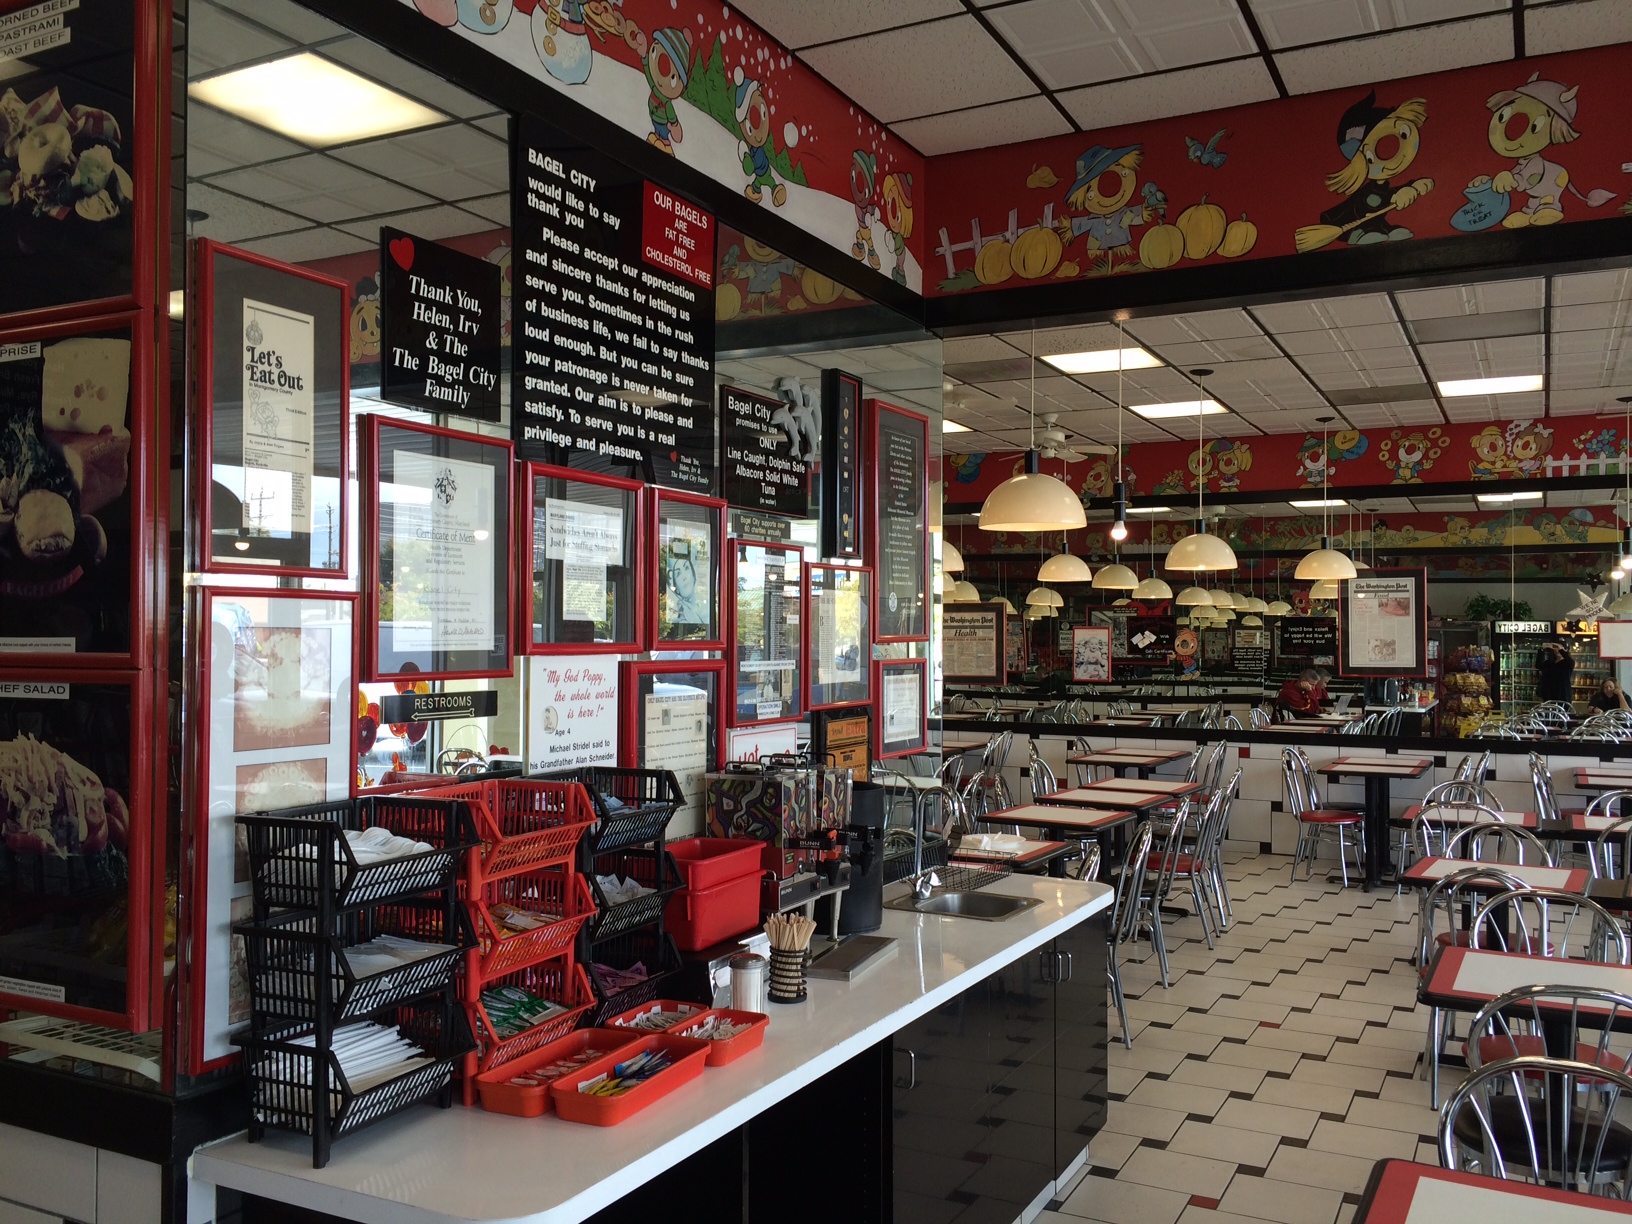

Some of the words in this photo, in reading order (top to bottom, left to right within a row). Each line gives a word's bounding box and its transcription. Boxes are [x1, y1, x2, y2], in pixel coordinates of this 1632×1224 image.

[34, 31, 65, 48] BEEF
[529, 148, 566, 179] BAGEL
[571, 170, 596, 192] CITY
[528, 177, 562, 201] would
[566, 191, 584, 211] like
[589, 203, 599, 218] to
[603, 212, 620, 230] say
[528, 193, 560, 218] thank
[565, 211, 584, 229] you
[654, 191, 672, 210] OUR
[675, 203, 707, 229] BAGELS
[1461, 202, 1485, 216] TRICK
[674, 219, 687, 233] ARE
[1468, 211, 1493, 226] TREAT
[665, 228, 676, 242] FAT
[679, 234, 695, 251] FREE
[543, 227, 580, 254] Please
[584, 248, 619, 271] accept
[623, 264, 638, 278] our
[642, 271, 695, 302] appreciation
[673, 246, 687, 260] AND
[646, 247, 693, 277] CHOLESTEROL
[695, 268, 711, 284] FREE
[409, 275, 452, 305] Thank
[456, 289, 482, 316] You,
[526, 249, 547, 266] and
[552, 258, 591, 283] sincere
[596, 276, 629, 298] thanks
[633, 288, 646, 304] for
[650, 295, 677, 320] letting
[680, 310, 690, 321] us
[412, 302, 453, 333] Helen,
[458, 314, 479, 336] Irv
[526, 275, 557, 294] serve
[562, 287, 584, 305] you.
[589, 295, 642, 325] Sometimes
[646, 316, 654, 329] in
[658, 321, 672, 336] the
[675, 330, 693, 344] rush
[426, 331, 438, 350] &
[444, 334, 468, 357] The
[526, 299, 536, 312] of
[541, 303, 589, 330] business
[593, 320, 611, 340] life,
[616, 330, 629, 343] we
[633, 334, 647, 350] fail
[651, 341, 659, 353] to
[663, 346, 678, 362] say
[682, 351, 709, 371] thanks
[0, 345, 37, 357] PRISE
[246, 346, 282, 369] Let's
[525, 322, 549, 342] loud
[554, 335, 595, 357] enough.
[600, 346, 617, 363] But
[621, 354, 637, 369] you
[642, 362, 658, 376] can
[662, 366, 672, 380] be
[676, 372, 694, 386] sure
[246, 364, 275, 385] Eat
[278, 370, 303, 390] Out
[393, 347, 419, 370] The
[428, 355, 463, 382] Bagel
[469, 366, 497, 391] City
[526, 351, 550, 366] your
[555, 359, 608, 384] patronage
[612, 373, 620, 387] is
[624, 378, 649, 395] never
[654, 386, 677, 403] taken
[681, 393, 693, 407] for
[424, 378, 470, 408] Family
[525, 377, 570, 398] granted.
[575, 386, 593, 403] Our
[599, 394, 616, 409] aim
[620, 398, 628, 411] is
[633, 402, 641, 415] to
[645, 407, 673, 424] please
[678, 414, 693, 429] and
[728, 396, 752, 415] Bagel
[755, 404, 770, 422] City
[525, 400, 564, 422] satisfy.
[569, 409, 581, 423] To
[585, 414, 613, 432] serve
[617, 423, 634, 438] you
[638, 426, 645, 439] is
[649, 431, 655, 441] a
[659, 432, 675, 446] real
[736, 418, 760, 430] promises
[525, 426, 572, 447] privilege
[577, 436, 595, 451] and
[600, 440, 643, 461] pleasure.
[760, 437, 777, 450] ONLY
[728, 446, 741, 459] Line
[744, 450, 767, 467] Caught,
[769, 456, 791, 473] Dolphin
[793, 462, 805, 473] Safe
[736, 464, 763, 480] Albacore
[766, 470, 780, 483] Solid
[782, 474, 798, 486] White
[761, 482, 775, 496] Tuna
[550, 524, 580, 536] Sandwiches
[741, 516, 751, 525] Bagel
[752, 518, 760, 526] City
[762, 520, 776, 528] supports
[416, 528, 449, 541] Certificate
[451, 531, 457, 541] of
[550, 537, 562, 548] Just
[572, 541, 593, 552] Stuffing
[950, 616, 980, 624] Washington
[564, 668, 579, 683] God
[23, 685, 65, 694] SALAD
[554, 690, 565, 702] the
[570, 688, 591, 701] whole
[595, 687, 616, 699] world
[415, 696, 472, 710] RESTROOMS
[567, 708, 574, 719] is
[555, 729, 565, 737] Age
[550, 745, 571, 753] Michael
[573, 741, 590, 751] Stridel
[592, 740, 603, 748] said
[605, 739, 610, 747] to
[530, 762, 538, 770] his
[540, 758, 573, 769] Grandfather
[576, 756, 588, 764] Alan
